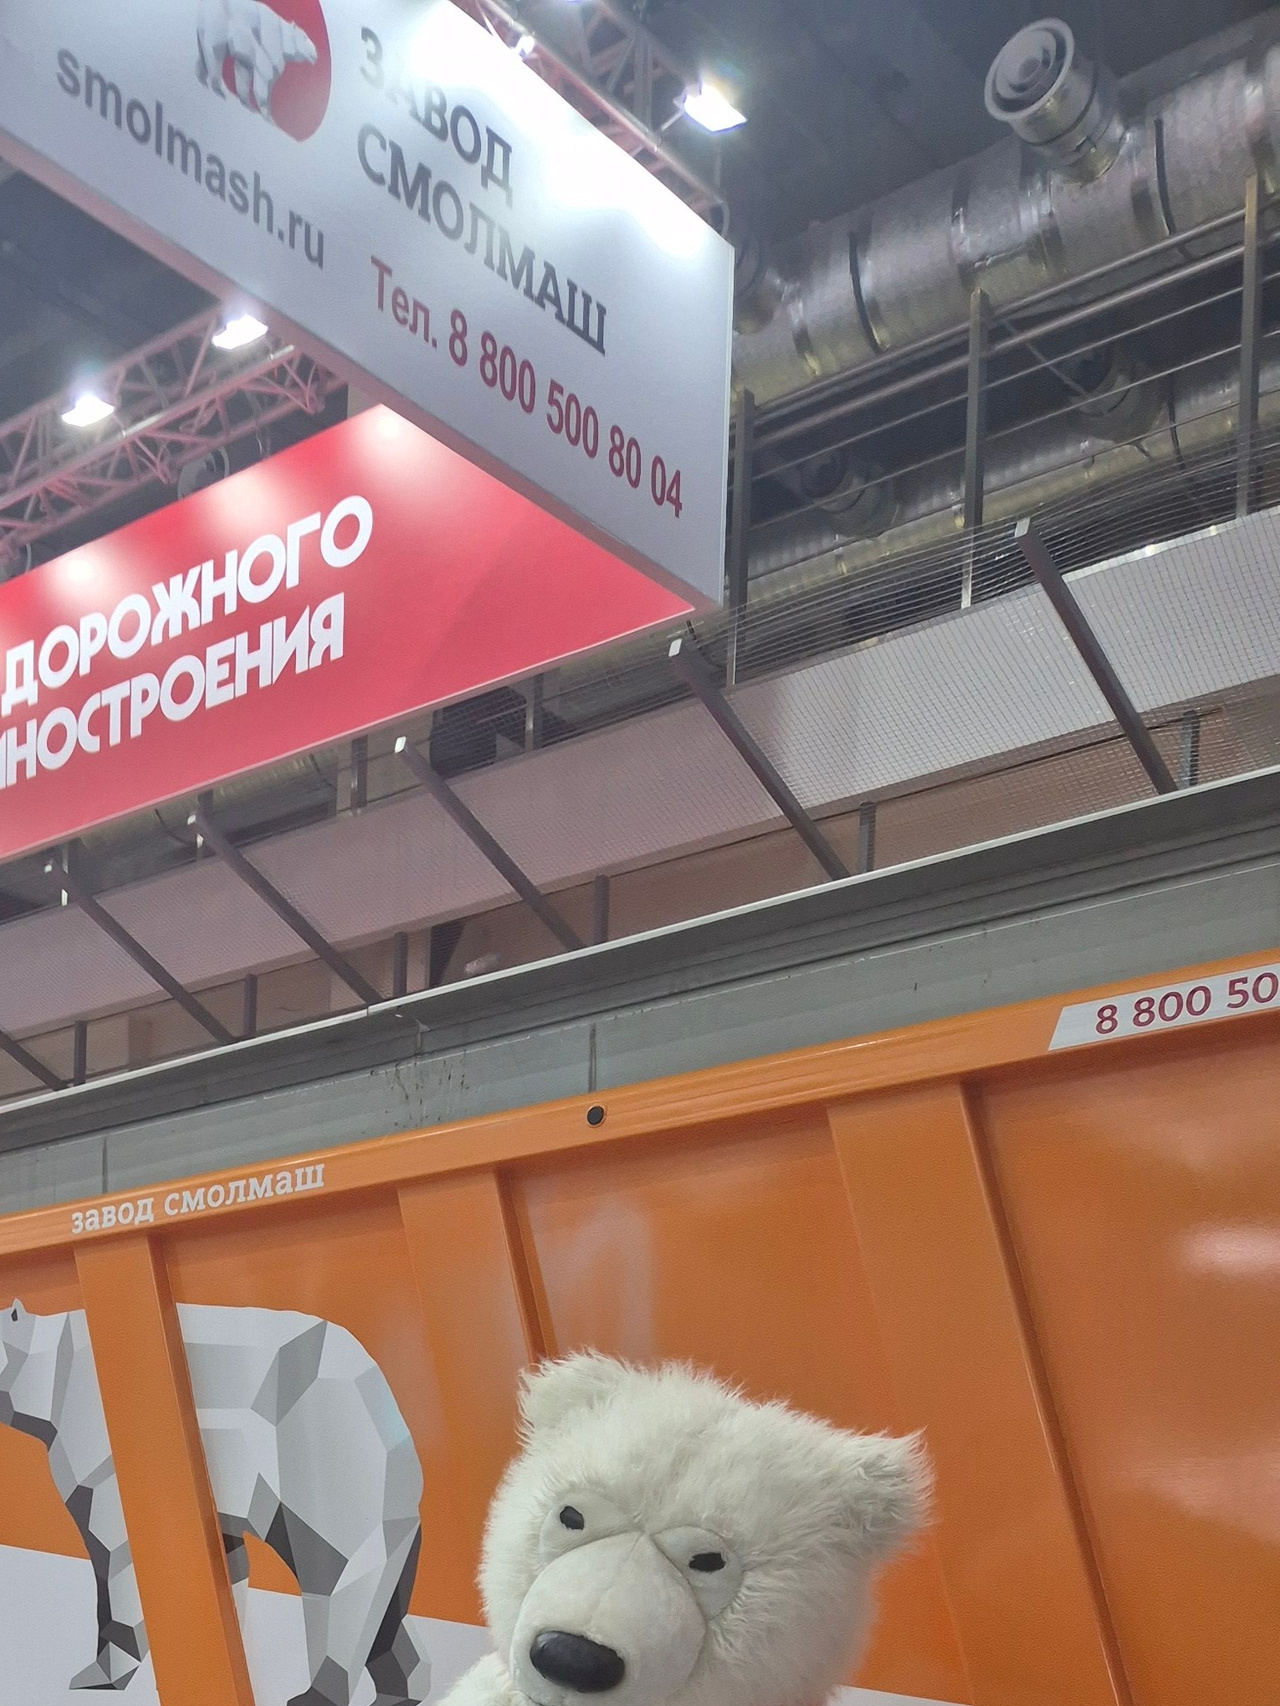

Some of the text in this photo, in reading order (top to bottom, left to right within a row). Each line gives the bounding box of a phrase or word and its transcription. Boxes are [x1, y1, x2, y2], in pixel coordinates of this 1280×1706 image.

[55, 49, 325, 269] smolmash.ru
[360, 26, 513, 208] ЗВОД
[357, 122, 608, 357] СМОЛМАШ
[370, 254, 683, 519] Тел. 8 800 500 80 04
[1, 495, 374, 715] ДОРОЖНОГО
[1095, 1004, 1118, 1035] 8
[1132, 985, 1212, 1027] 800
